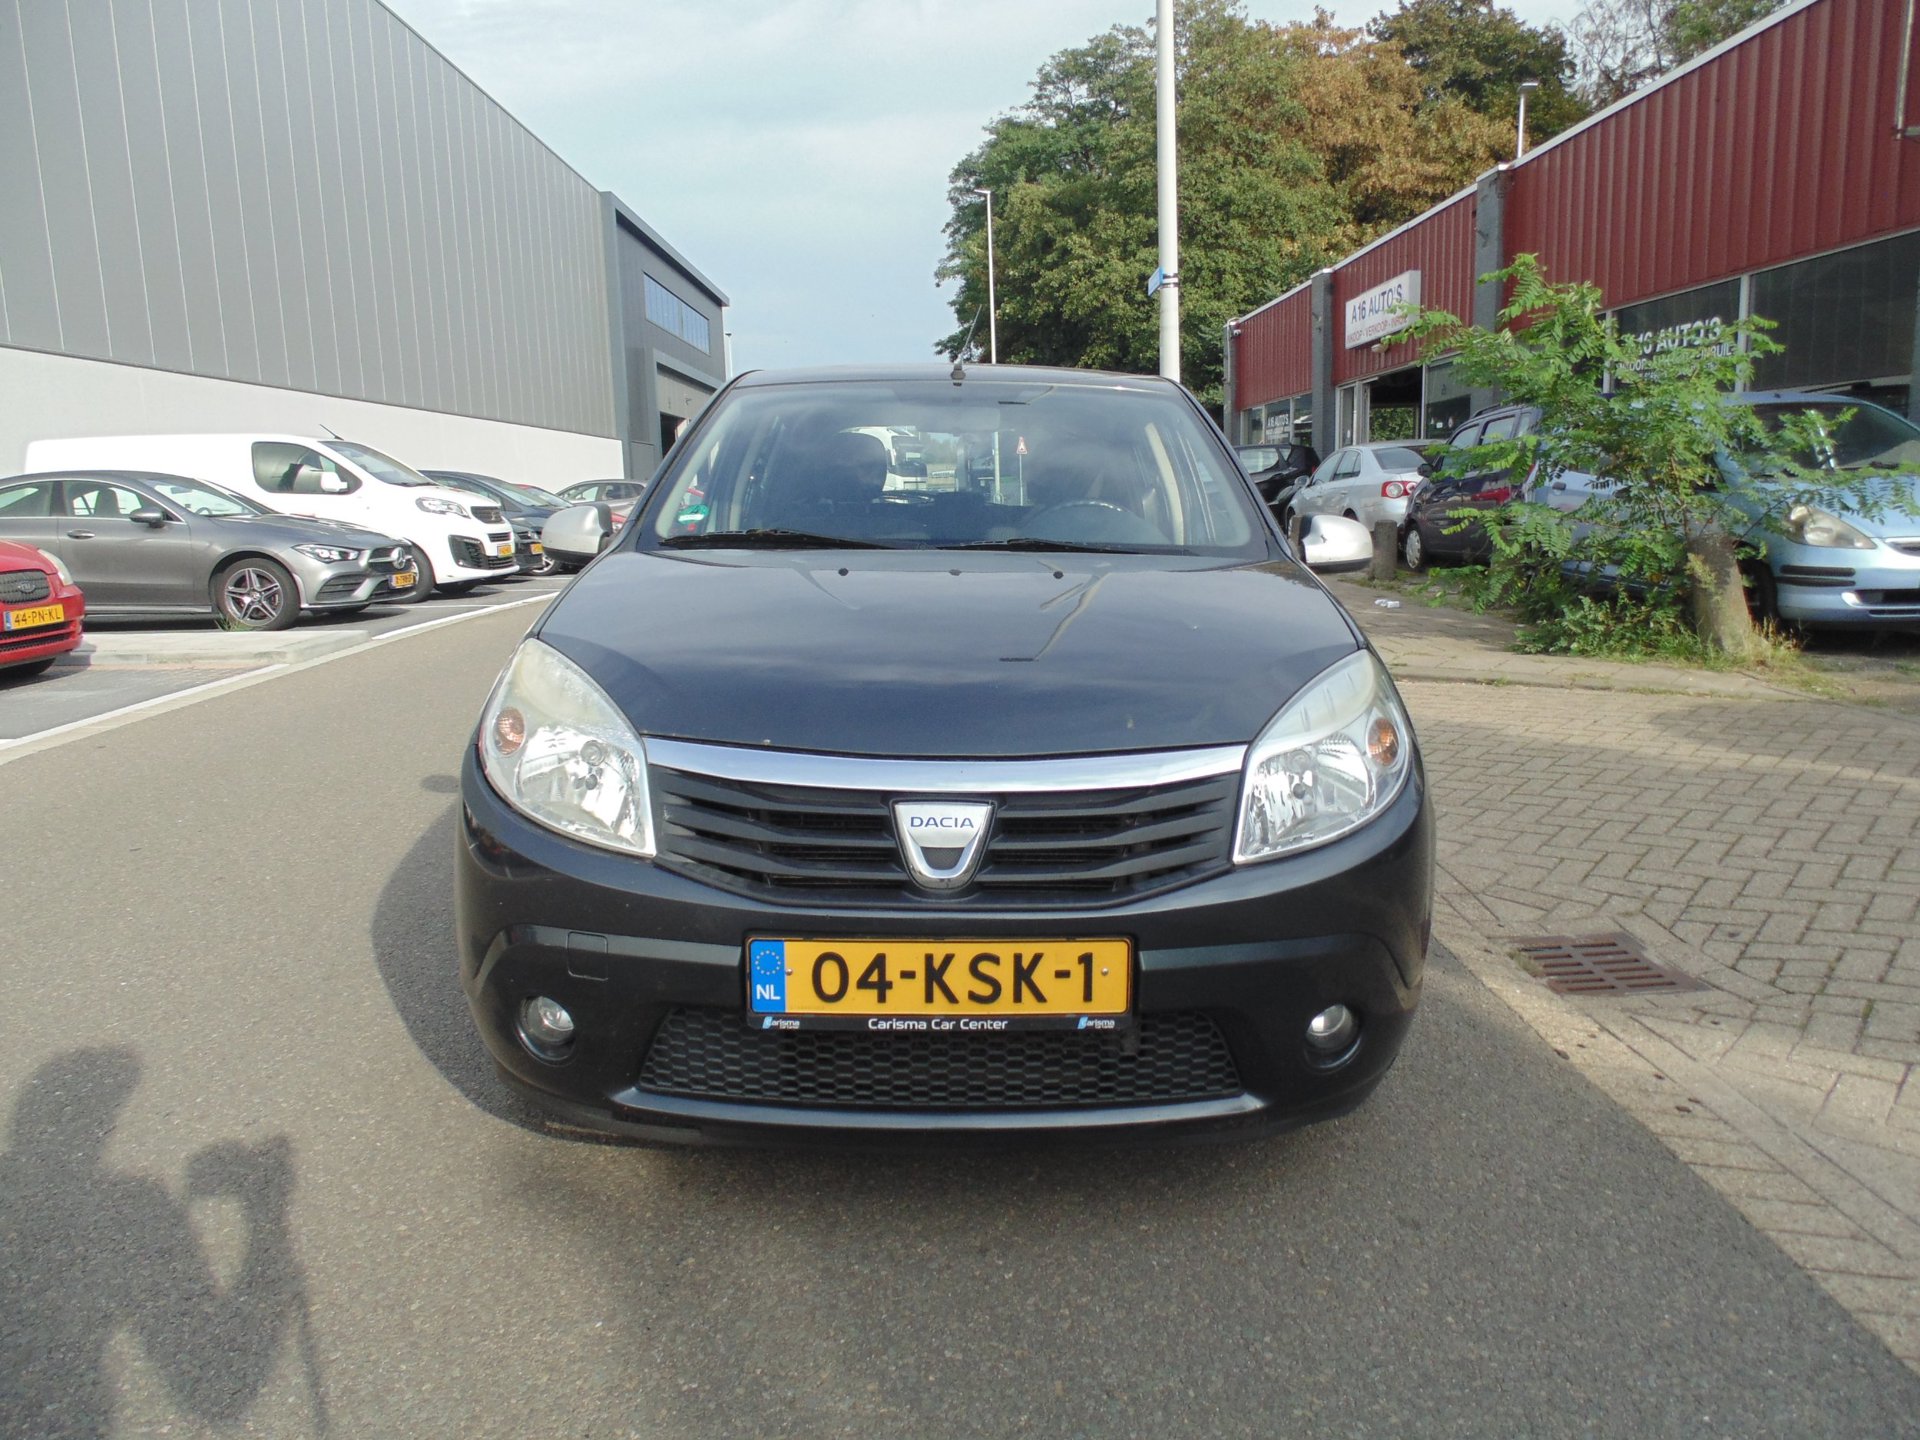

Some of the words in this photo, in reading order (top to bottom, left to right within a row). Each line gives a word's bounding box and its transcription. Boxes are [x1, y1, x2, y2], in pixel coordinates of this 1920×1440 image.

[1352, 301, 1366, 324] A16
[1369, 284, 1402, 317] AUTO'S
[15, 608, 61, 625] 44-PN-KL
[910, 816, 974, 829] DACIA
[812, 951, 1093, 1004] 04-KSK-1
[756, 984, 781, 1000] NL
[868, 1018, 926, 1030] Carisma
[931, 1018, 956, 1030] Car
[960, 1018, 1008, 1030] Center
